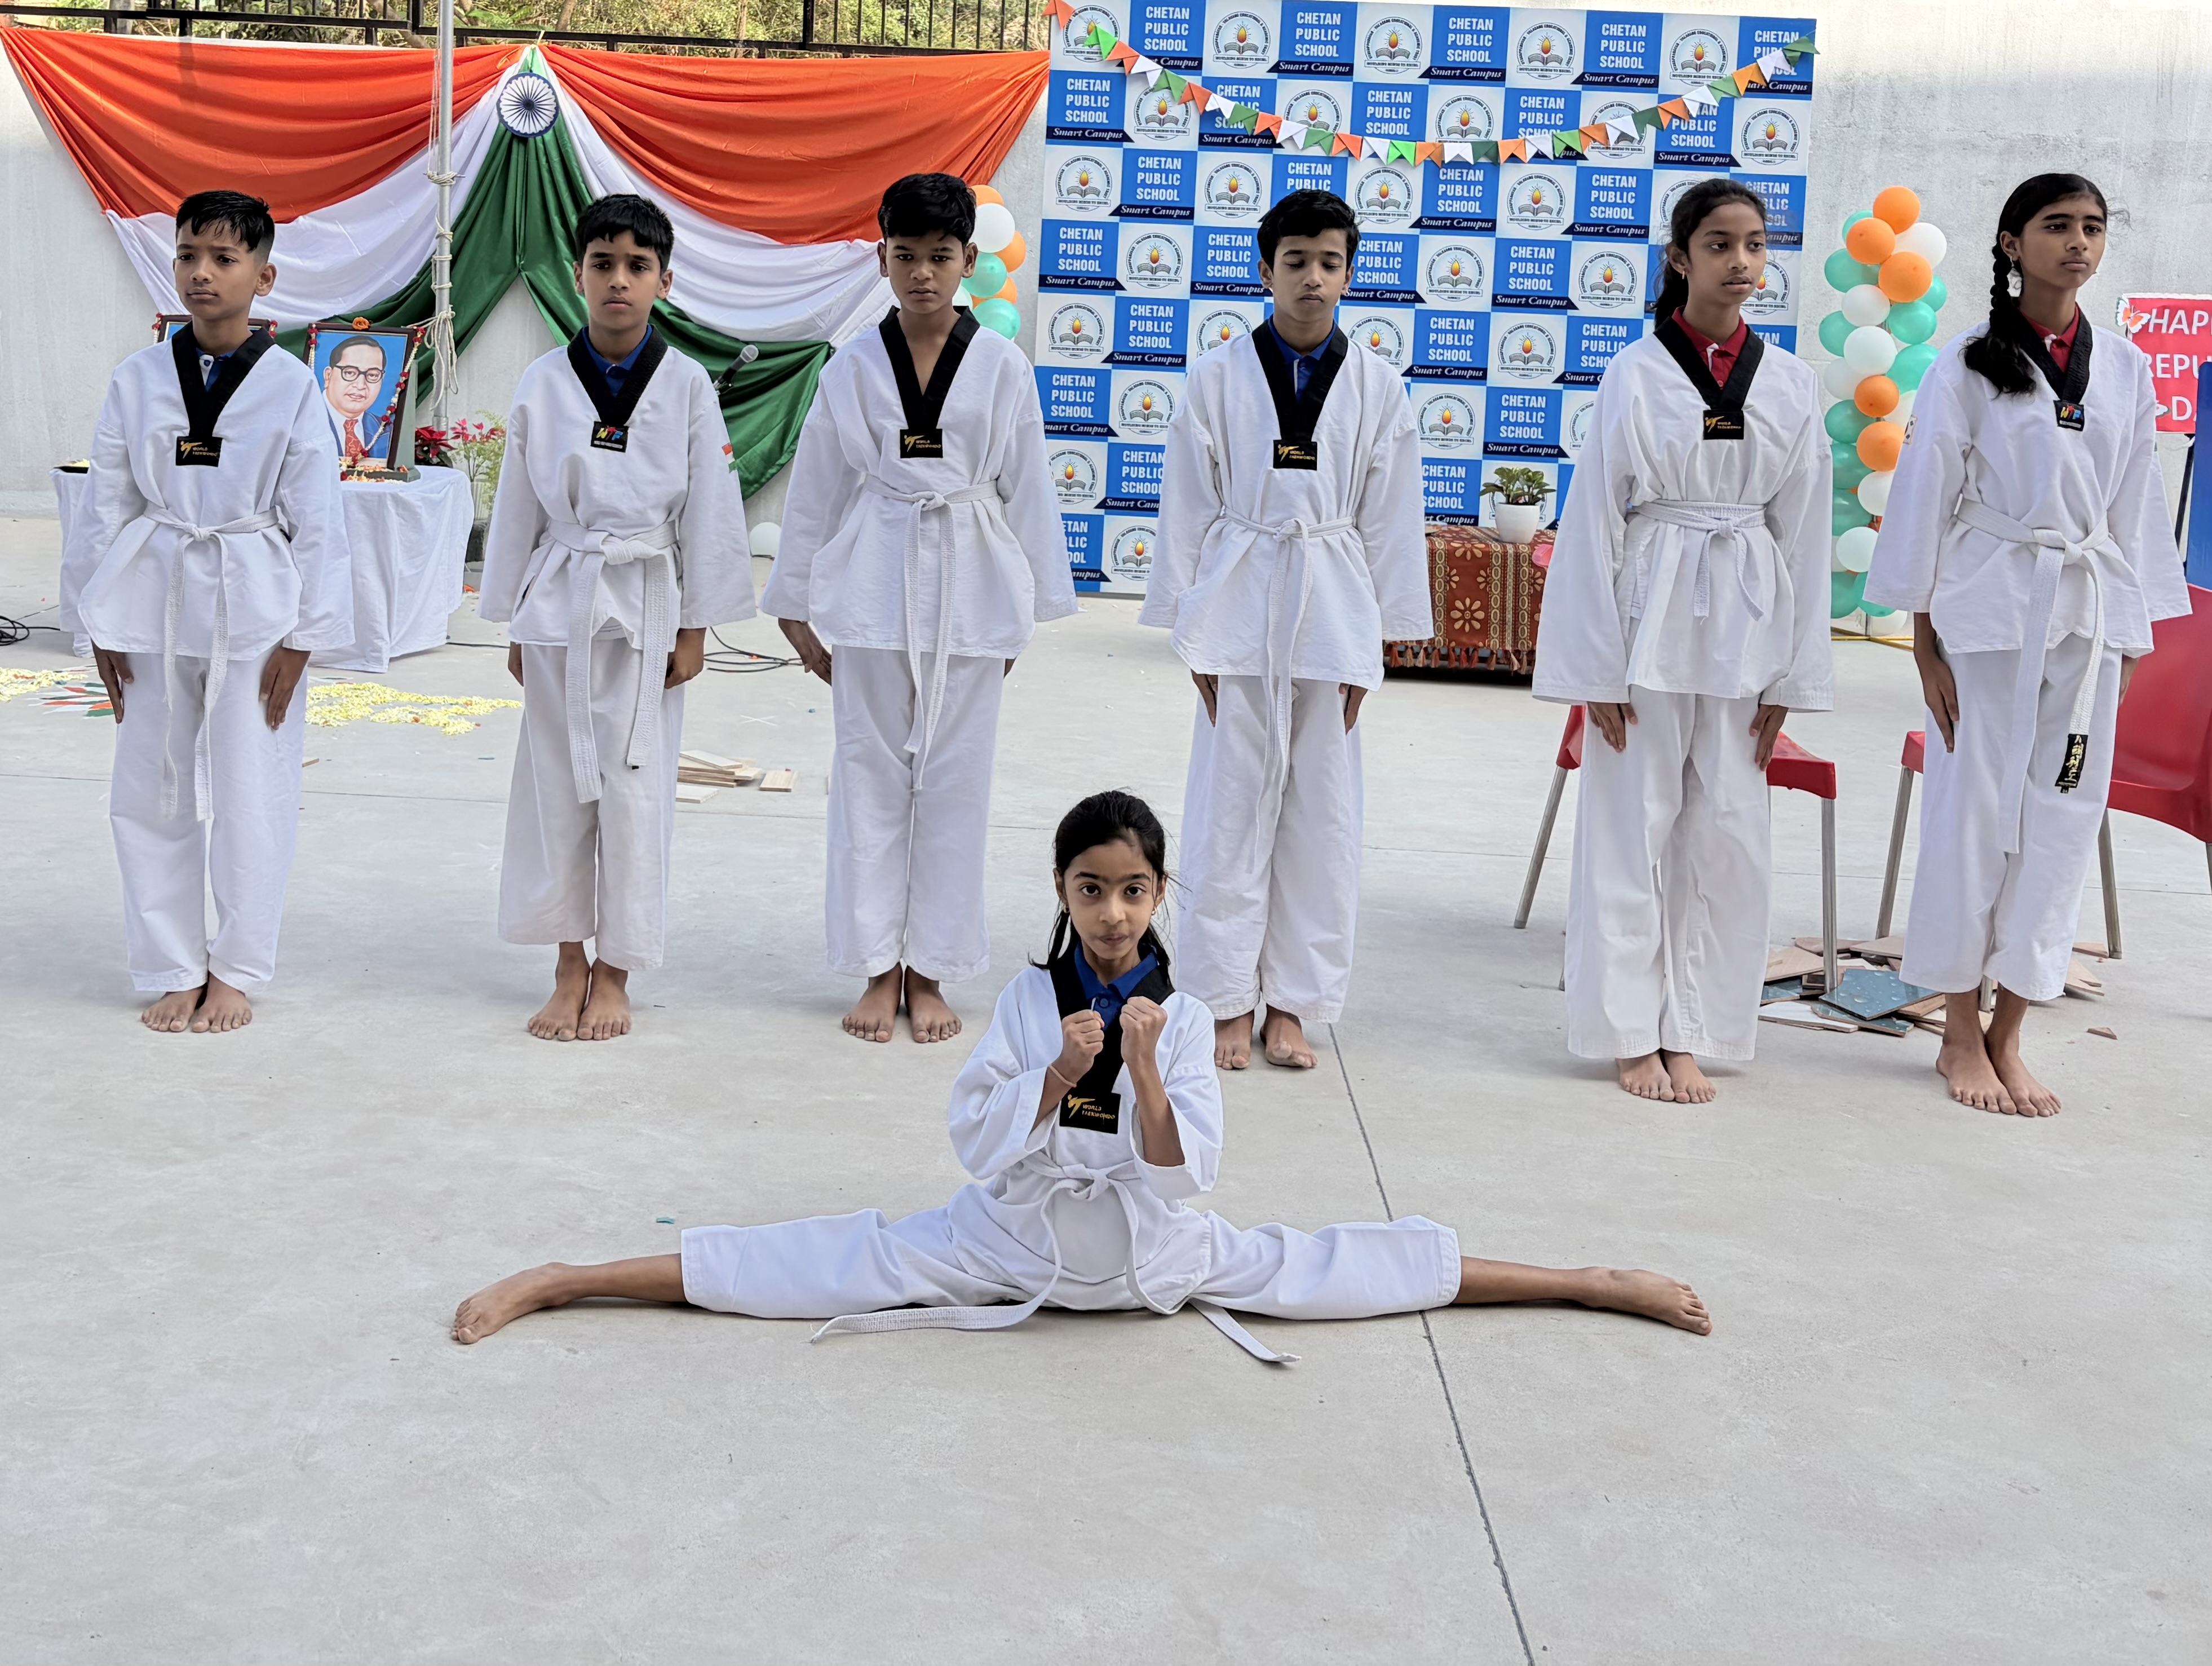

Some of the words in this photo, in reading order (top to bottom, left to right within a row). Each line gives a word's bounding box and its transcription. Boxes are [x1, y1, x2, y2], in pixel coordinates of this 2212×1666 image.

[1146, 6, 1189, 20] CHETAN
[1297, 12, 1341, 25] CHETAN
[1145, 22, 1189, 36] PUBLIC
[1449, 17, 1493, 30] CHETAN
[1295, 28, 1340, 41] PUBLIC
[1602, 24, 1647, 37] CHETAN
[1754, 30, 1799, 43] CHETAN
[1144, 38, 1188, 51] SCHOOL
[1448, 33, 1492, 47] PUBLIC
[1600, 39, 1645, 53] PUBLIC
[1295, 43, 1339, 57] SCHOOL
[1446, 49, 1491, 63] SCHOOL
[1160, 57, 1198, 68] Campus
[1278, 62, 1309, 70] Smart
[1311, 63, 1350, 74] Campus
[1599, 55, 1644, 69] SCHOOL
[1430, 67, 1462, 76] Smart
[1463, 68, 1502, 79] Campus
[1583, 73, 1615, 82] Smart
[1616, 74, 1655, 86] Campus
[1067, 78, 1111, 92] CHETAN
[1216, 85, 1261, 98] CHETAN
[1769, 81, 1808, 92] Campus
[1066, 94, 1109, 108] PUBLIC
[1368, 90, 1412, 103] CHETAN
[1520, 96, 1565, 109] CHETAN
[1065, 110, 1109, 123] SCHOOL
[1366, 106, 1411, 120] PUBLIC
[1519, 112, 1563, 125] PUBLIC
[1365, 122, 1410, 135] SCHOOL
[1671, 118, 1717, 132] PUBLIC
[1053, 128, 1084, 136] Smart
[1085, 129, 1123, 140] Campus
[1202, 134, 1233, 143] Smart
[1235, 135, 1272, 147] Campus
[1671, 134, 1715, 148] SCHOOL
[1138, 156, 1182, 170] CHETAN
[1658, 152, 1690, 161] Smart
[1691, 154, 1730, 165] Campus
[1288, 162, 1332, 175] CHETAN
[1439, 168, 1484, 182] CHETAN
[1137, 172, 1180, 185] PUBLIC
[1286, 178, 1331, 191] PUBLIC
[1592, 174, 1636, 188] CHETAN
[1136, 188, 1180, 201] SCHOOL
[1438, 184, 1483, 197] PUBLIC
[1745, 181, 1790, 195] CHETAN
[1591, 190, 1635, 204] PUBLIC
[1121, 205, 1151, 214] Smart
[1152, 207, 1191, 218] Campus
[1437, 200, 1481, 213] SCHOOL
[1590, 206, 1634, 220] SCHOOL
[1421, 217, 1453, 227] Smart
[1453, 219, 1493, 230] Campus
[1574, 224, 1605, 233] Smart
[1606, 226, 1645, 236] Campus
[1060, 227, 1103, 241] CHETAN
[1208, 233, 1252, 247] CHETAN
[1766, 234, 1799, 243] ampus
[1059, 243, 1102, 256] PUBLIC
[1359, 240, 1403, 253] CHETAN
[1510, 246, 1555, 259] CHETAN
[1207, 249, 1251, 263] PUBLIC
[1357, 255, 1401, 269] PUBLIC
[1058, 258, 1101, 272] SCHOOL
[1206, 265, 1250, 278] SCHOOL
[1509, 262, 1554, 275] PUBLIC
[1046, 276, 1076, 285] Smart
[1077, 277, 1116, 289] Campus
[1356, 271, 1401, 285] SCHOOL
[1508, 277, 1553, 291] SCHOOL
[1195, 283, 1225, 291] Smart
[1226, 284, 1264, 295] Campus
[1344, 289, 1375, 298] Smart
[1376, 290, 1415, 301] Campus
[1496, 295, 1528, 304] Smart
[1528, 297, 1567, 308] Campus
[1130, 304, 1174, 317] CHETAN
[1129, 320, 1173, 333] PUBLIC
[1430, 317, 1475, 330] CHETAN
[1582, 324, 1627, 338] CHETAN
[1129, 335, 1172, 348] SCHOOL
[1429, 333, 1474, 346] PUBLIC
[1581, 339, 1626, 353] PUBLIC
[1113, 353, 1143, 361] Smart
[1144, 354, 1183, 365] Campus
[1428, 348, 1472, 362] SCHOOL
[1580, 355, 1611, 368] SCHO
[1412, 366, 1444, 375] Smart
[1444, 368, 1483, 378] Campus
[1564, 373, 1595, 382] Smart
[1052, 374, 1095, 387] CHETAN
[1051, 390, 1095, 403] PUBLIC
[1501, 394, 1546, 408] CHETAN
[1051, 405, 1094, 418] SCHOOL
[1501, 410, 1545, 423] PUBLIC
[1070, 424, 1108, 435] Campus
[1499, 426, 1544, 439] SCHOOL
[1487, 443, 1519, 452] Smart
[1519, 445, 1558, 456] Campus
[1122, 450, 1164, 464] CHETAN
[1422, 465, 1466, 479] CHETAN
[1423, 480, 1465, 494] PUBLIC
[1105, 498, 1136, 507] Smart
[1423, 495, 1465, 509] SCHOOL
[1435, 514, 1475, 525] Campus
[1072, 571, 1101, 580] ampus
